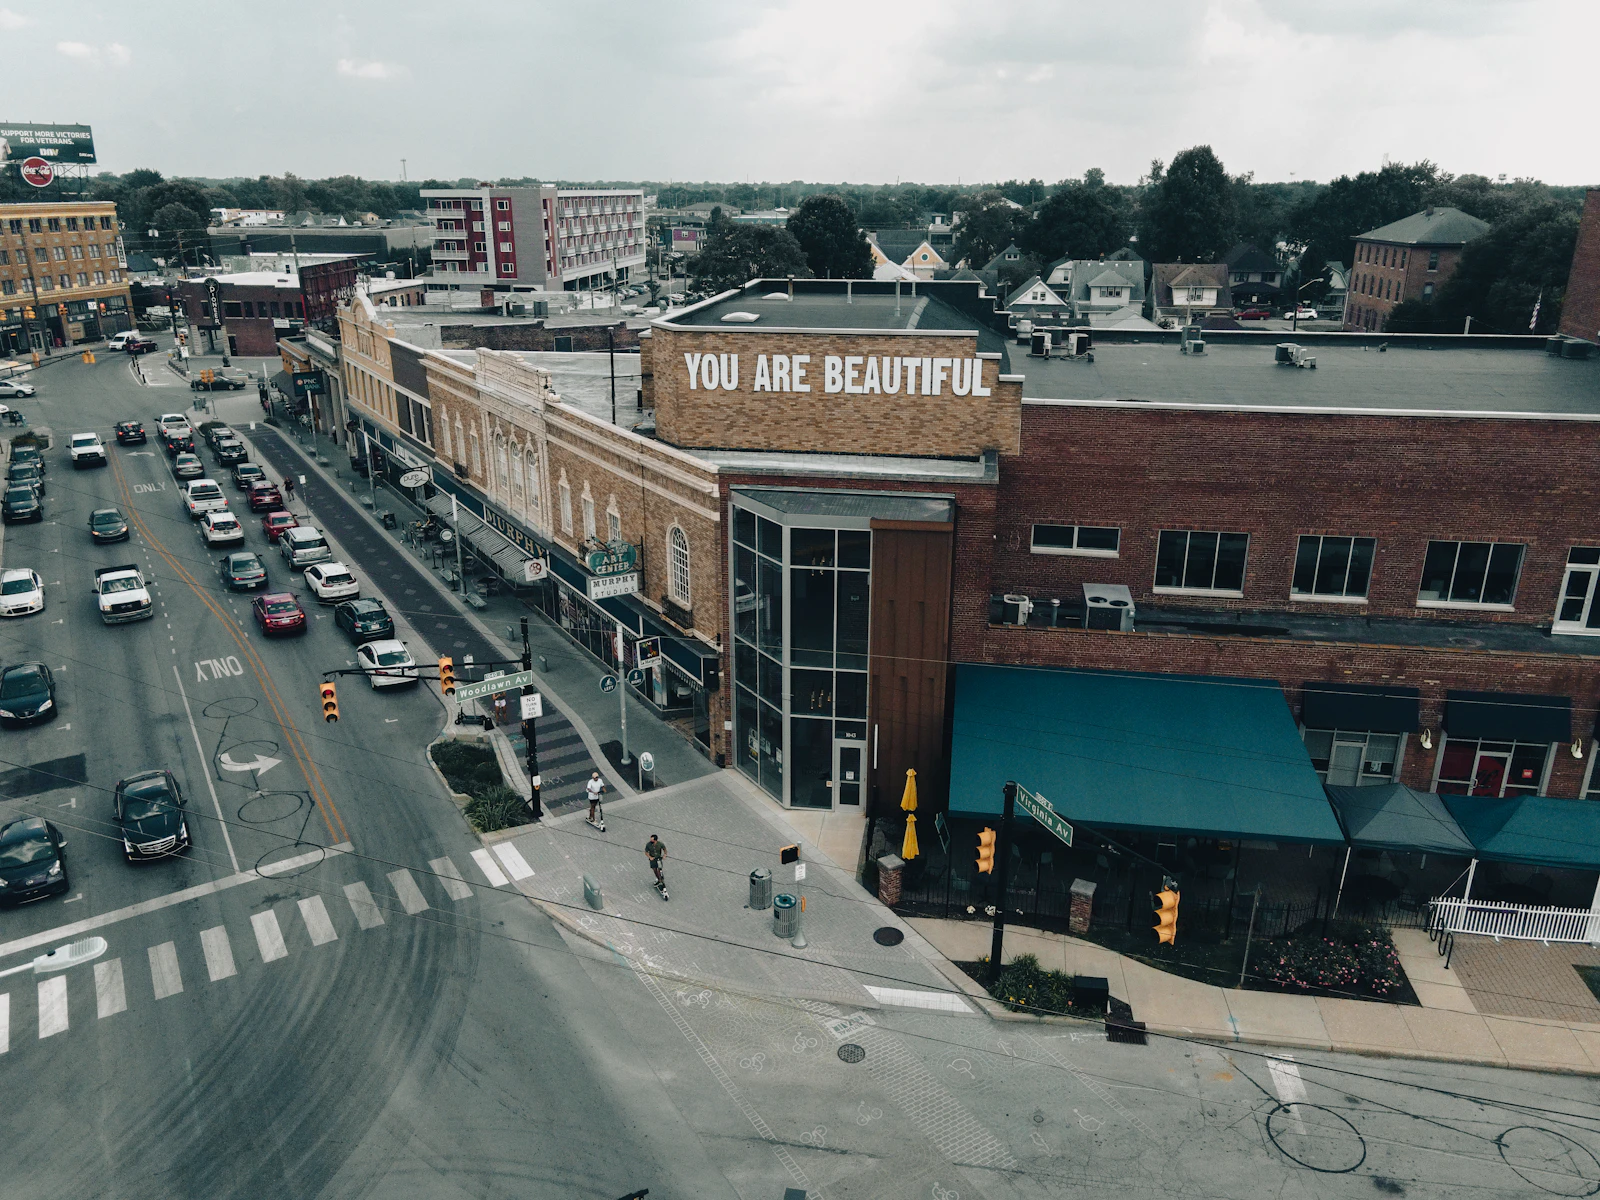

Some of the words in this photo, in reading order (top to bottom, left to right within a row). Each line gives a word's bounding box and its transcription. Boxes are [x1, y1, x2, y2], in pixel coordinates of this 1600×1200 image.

[0, 129, 33, 137] SUPPORT
[34, 130, 55, 138] MORE
[55, 131, 91, 139] VICTORIES
[35, 137, 75, 145] VETERANS.
[209, 286, 221, 325] PIONEER
[684, 352, 739, 391] YOU
[753, 354, 811, 392] ARE
[824, 355, 991, 397] BEAUTIFUL
[403, 473, 420, 482] pure
[133, 481, 166, 494] ONLY
[486, 508, 546, 558] MURPHY
[602, 553, 624, 564] ART
[596, 561, 630, 574] CENTER
[593, 574, 636, 588] MURPHY
[595, 586, 635, 598] STUDIOS
[194, 655, 244, 682] ONLY
[460, 680, 511, 698] Woodlawn
[515, 675, 528, 684] Av
[1020, 790, 1053, 826] Virginia
[1056, 822, 1069, 838] Av
